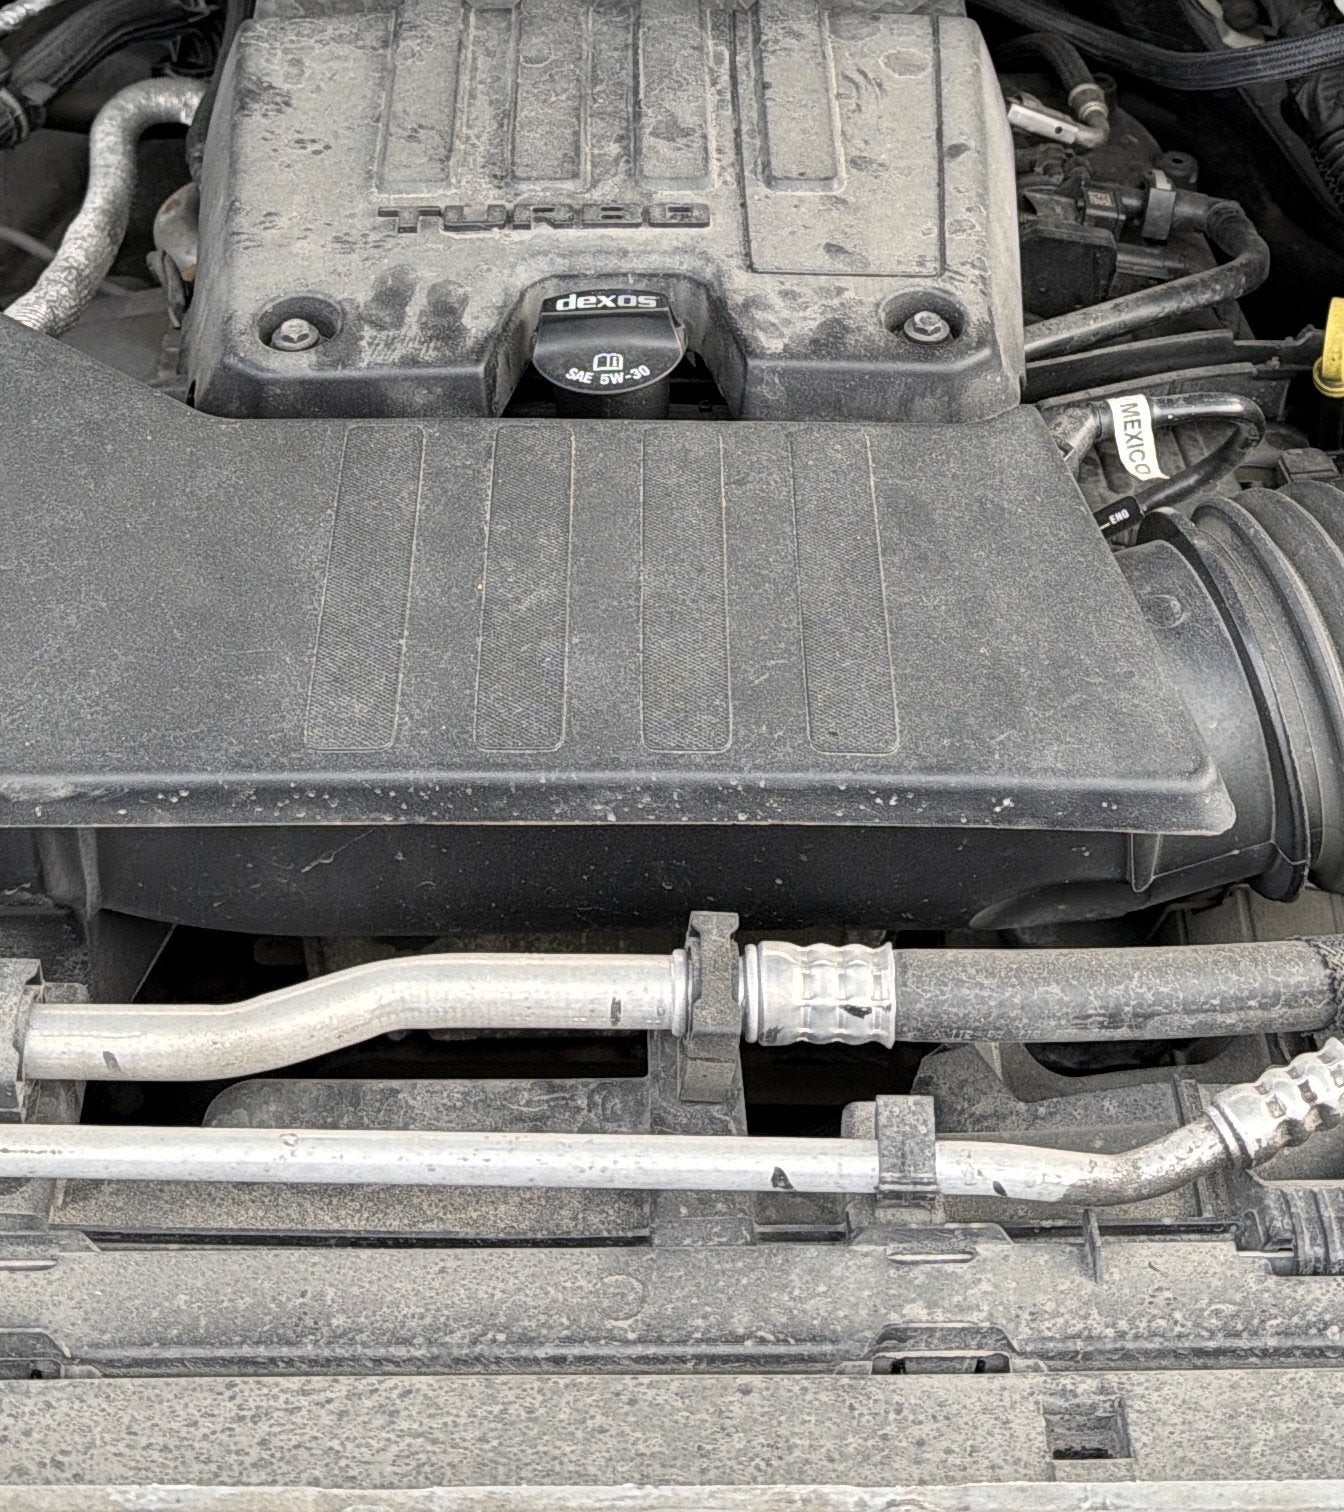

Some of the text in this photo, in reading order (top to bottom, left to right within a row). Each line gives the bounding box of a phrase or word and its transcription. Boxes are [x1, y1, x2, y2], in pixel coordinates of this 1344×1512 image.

[377, 203, 711, 234] TURBO
[555, 292, 659, 312] dexos
[565, 365, 651, 386] SAE 5W-30
[1119, 402, 1151, 475] MEXICO
